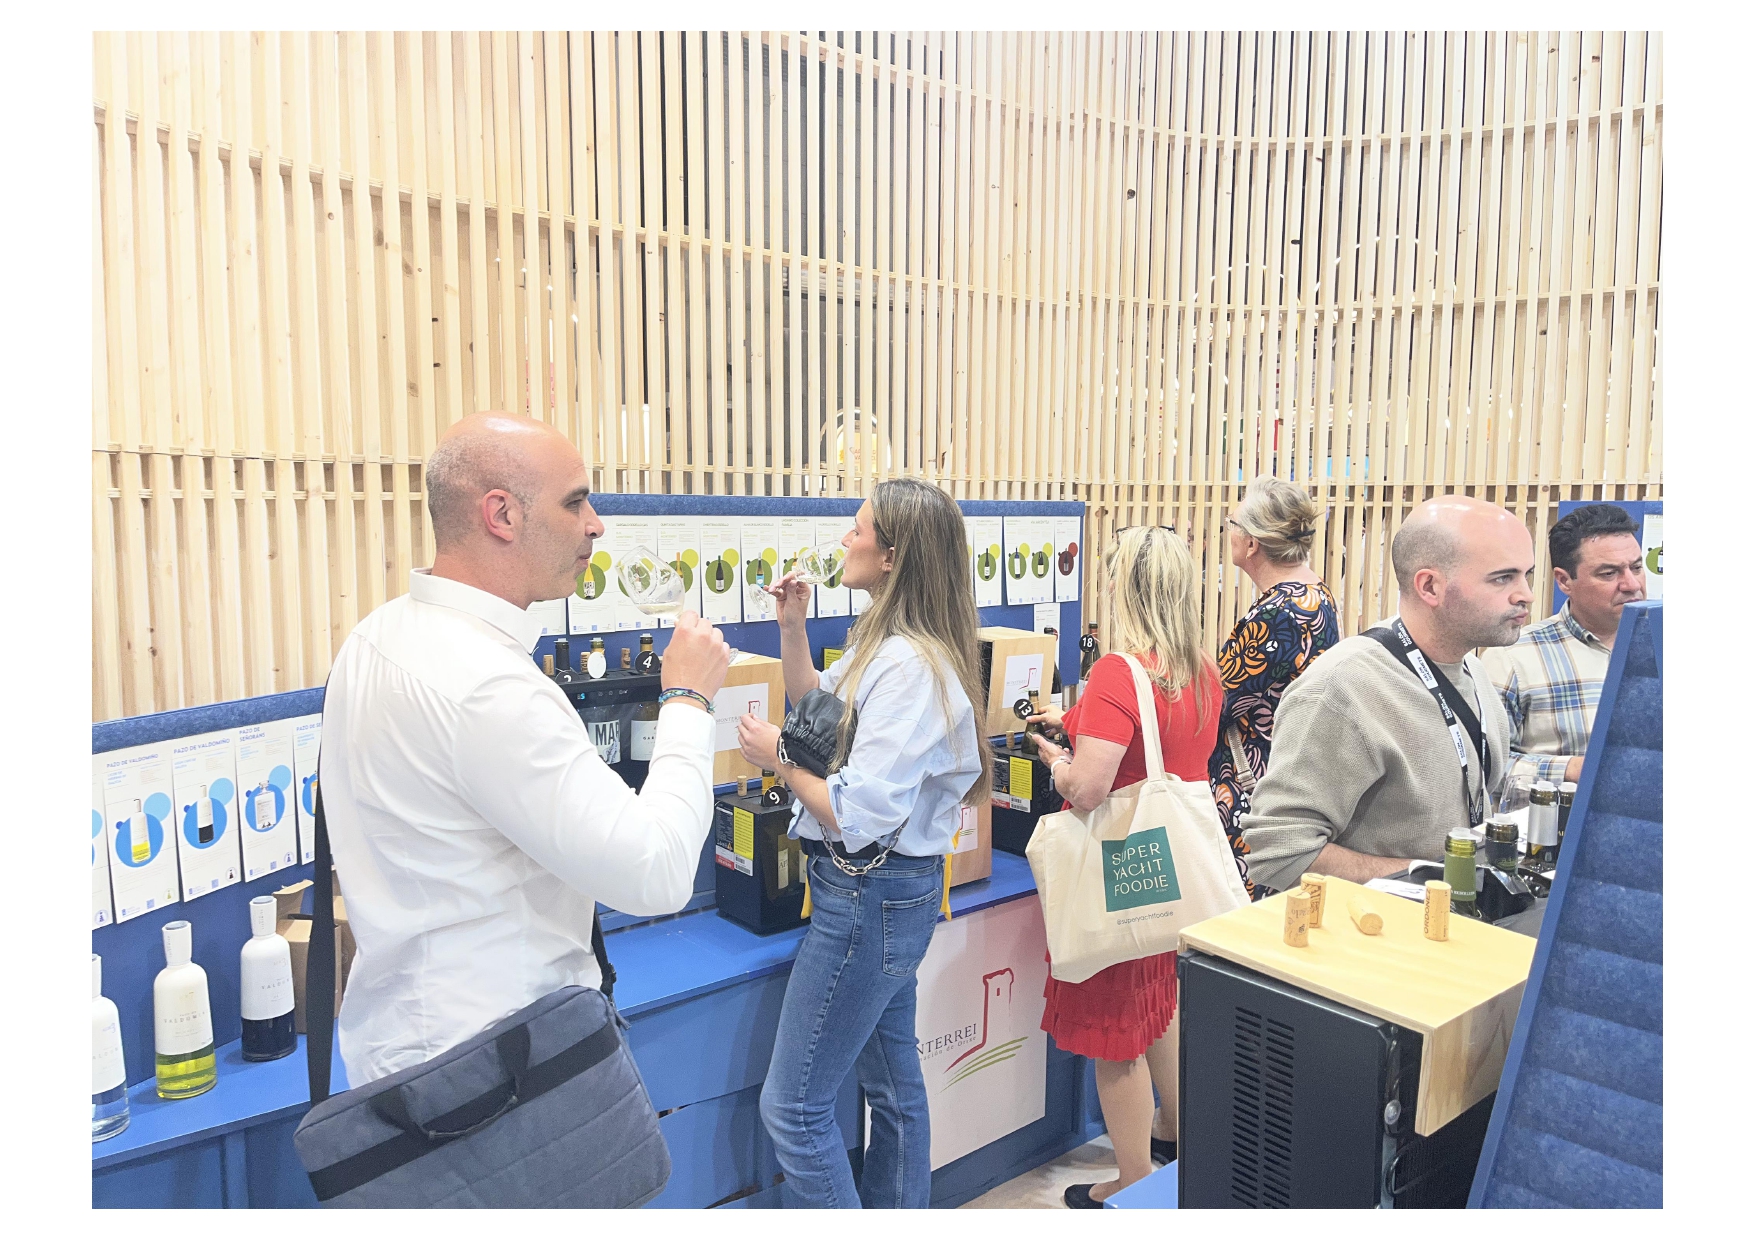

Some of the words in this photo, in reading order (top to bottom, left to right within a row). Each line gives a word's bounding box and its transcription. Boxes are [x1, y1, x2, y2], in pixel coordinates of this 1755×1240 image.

[1083, 637, 1093, 648] 18
[642, 655, 653, 669] 4
[1018, 701, 1032, 716] 13
[174, 746, 189, 755] PAZO
[189, 744, 197, 752] DE
[198, 738, 231, 750] VALDOMIÑO
[106, 760, 121, 768] PAZO
[769, 791, 781, 805] 9
[1112, 842, 1160, 866] SUPER
[1113, 858, 1163, 881] YACHT
[1114, 875, 1169, 897] FOODIE
[1116, 910, 1174, 925] @superyachtfoodie
[957, 1036, 977, 1047] Orixe
